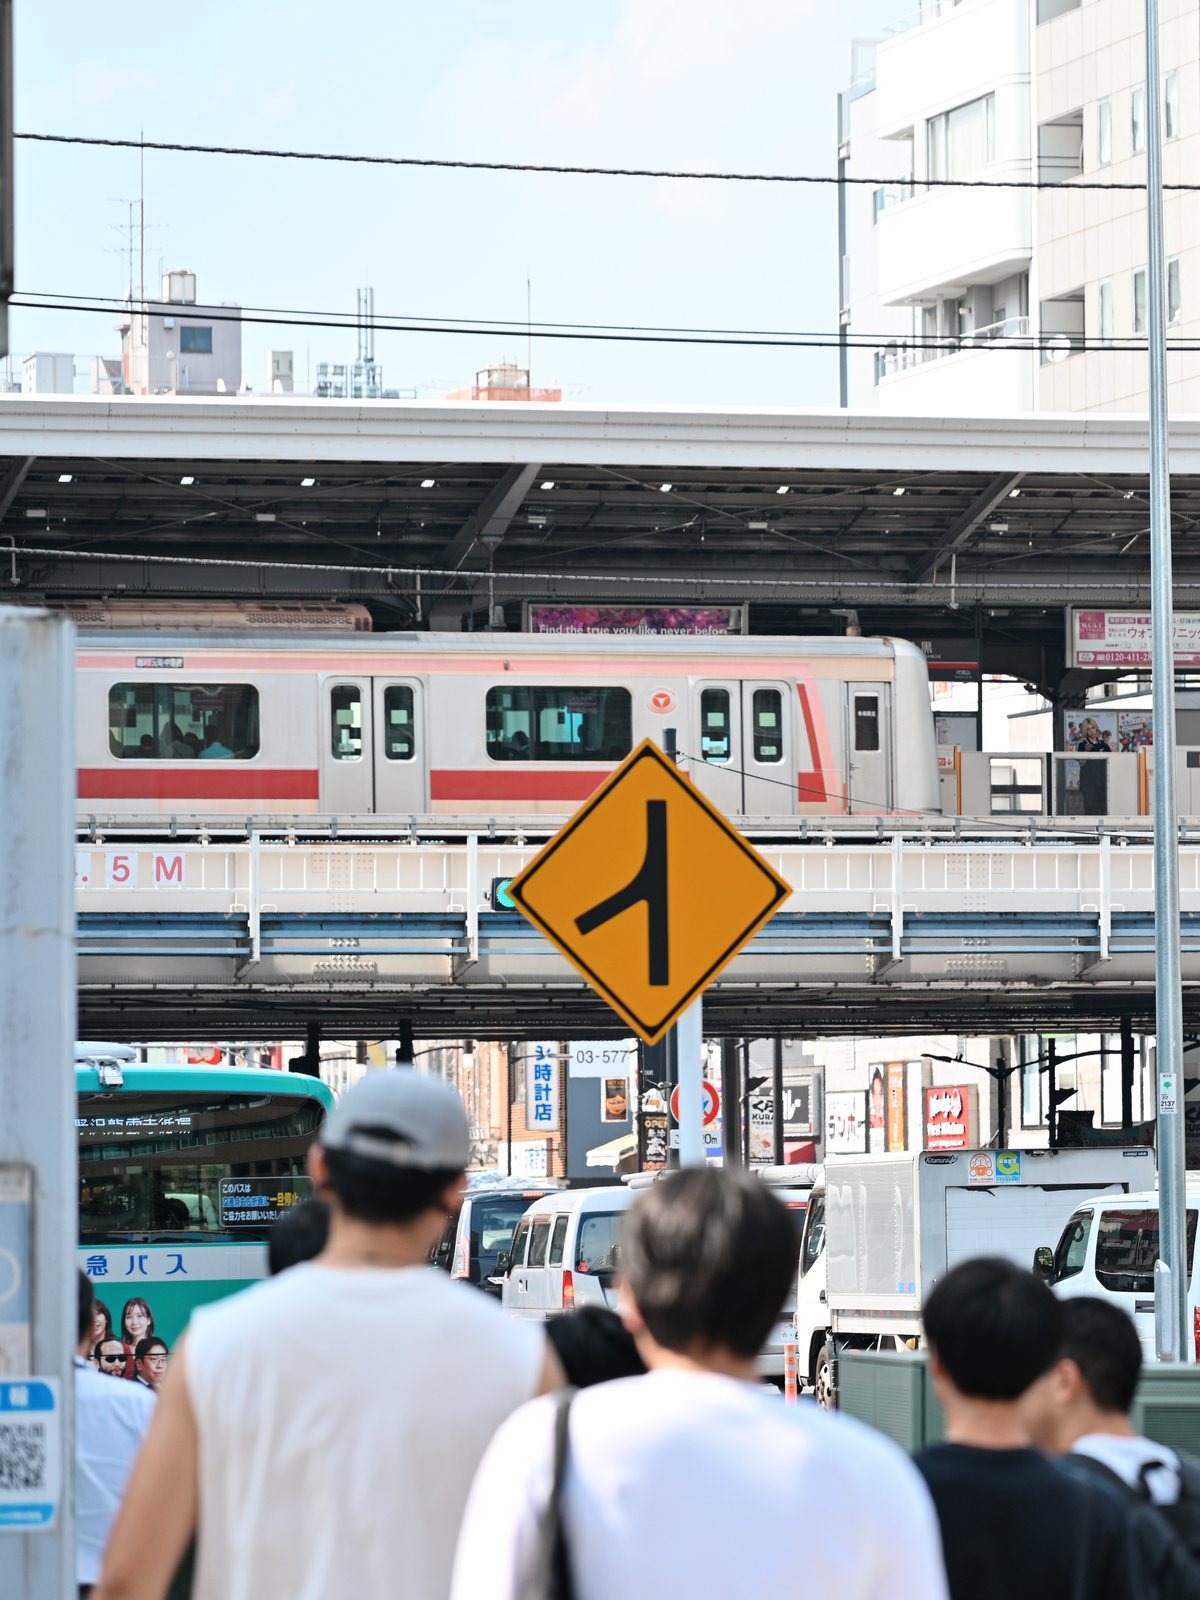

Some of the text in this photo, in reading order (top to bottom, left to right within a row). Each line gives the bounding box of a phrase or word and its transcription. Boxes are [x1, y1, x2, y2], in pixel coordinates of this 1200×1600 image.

[539, 624, 562, 635] Find
[566, 624, 583, 635] the
[638, 625, 656, 635] like
[1105, 653, 1152, 661] 0120-411-28
[222, 1183, 251, 1194] このバスは
[222, 1210, 288, 1221] ご協力をお願いいたし
